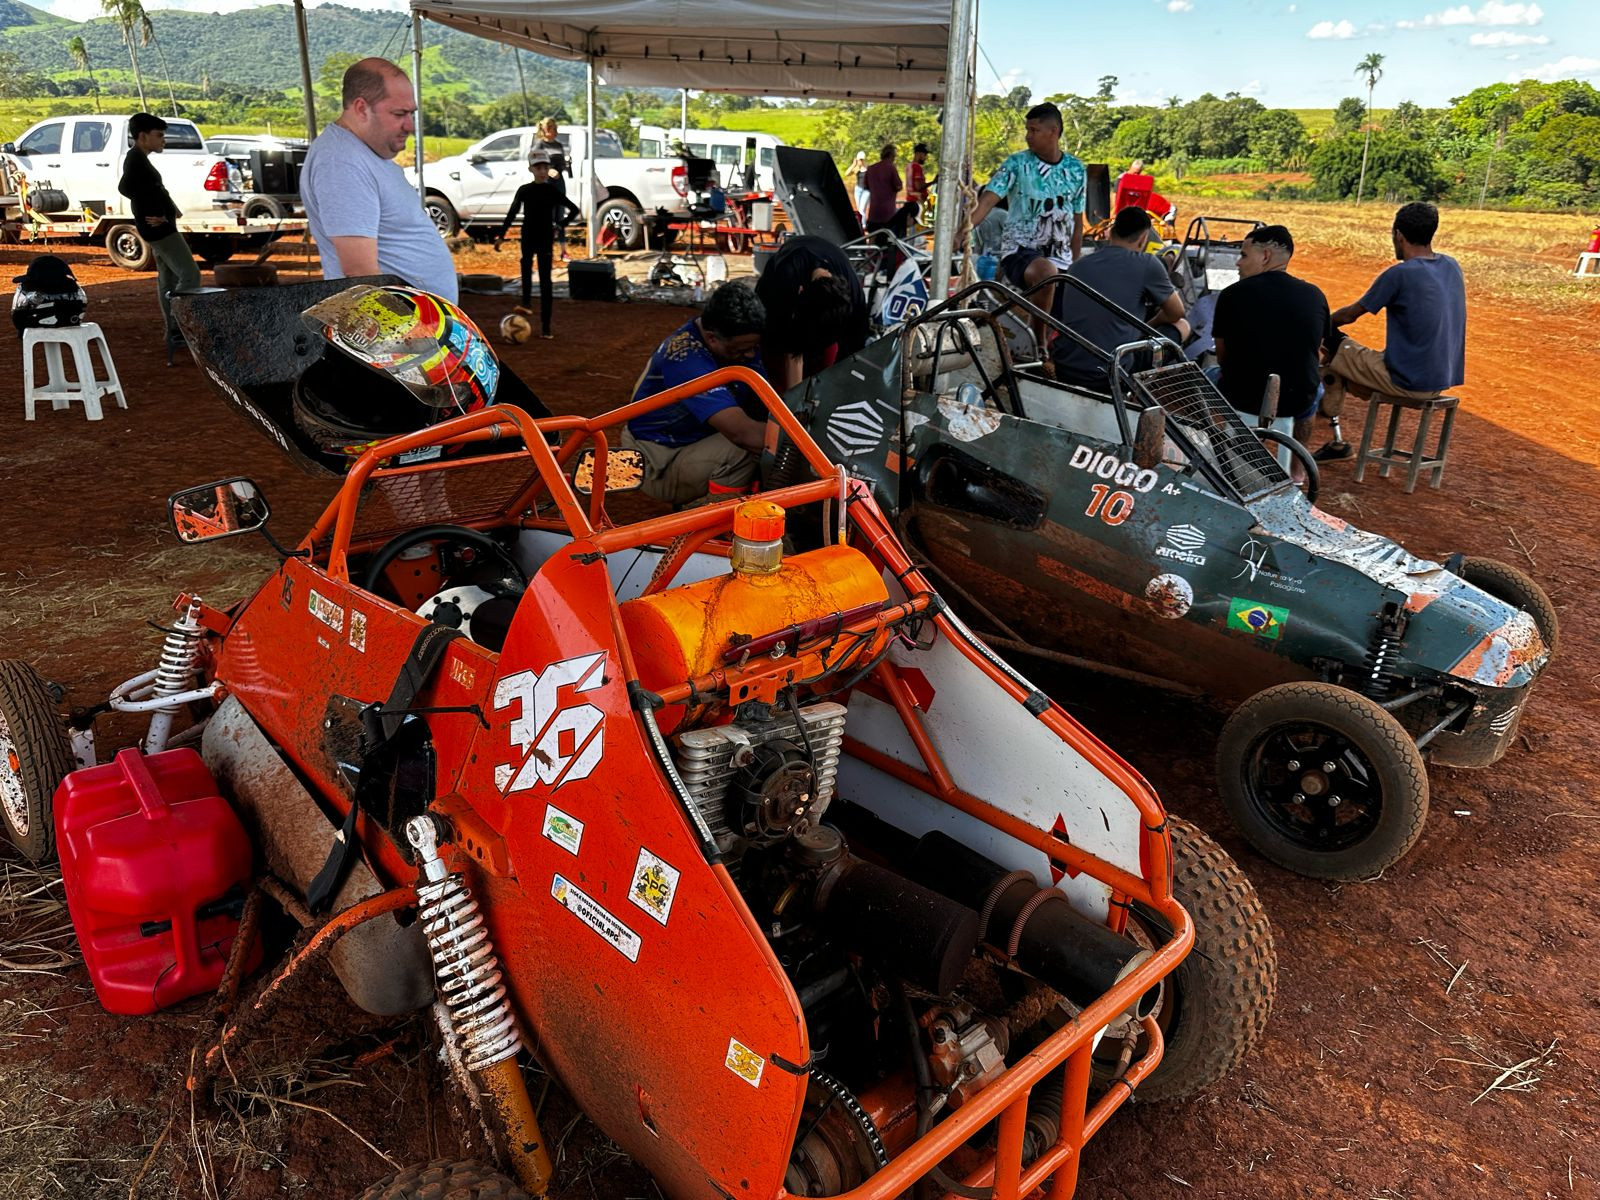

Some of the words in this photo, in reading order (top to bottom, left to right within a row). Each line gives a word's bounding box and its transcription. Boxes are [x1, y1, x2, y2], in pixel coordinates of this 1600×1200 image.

[1068, 444, 1158, 493] DIOGO
[1161, 483, 1181, 496] A+
[1085, 484, 1135, 526] 10
[493, 650, 609, 799] 36
